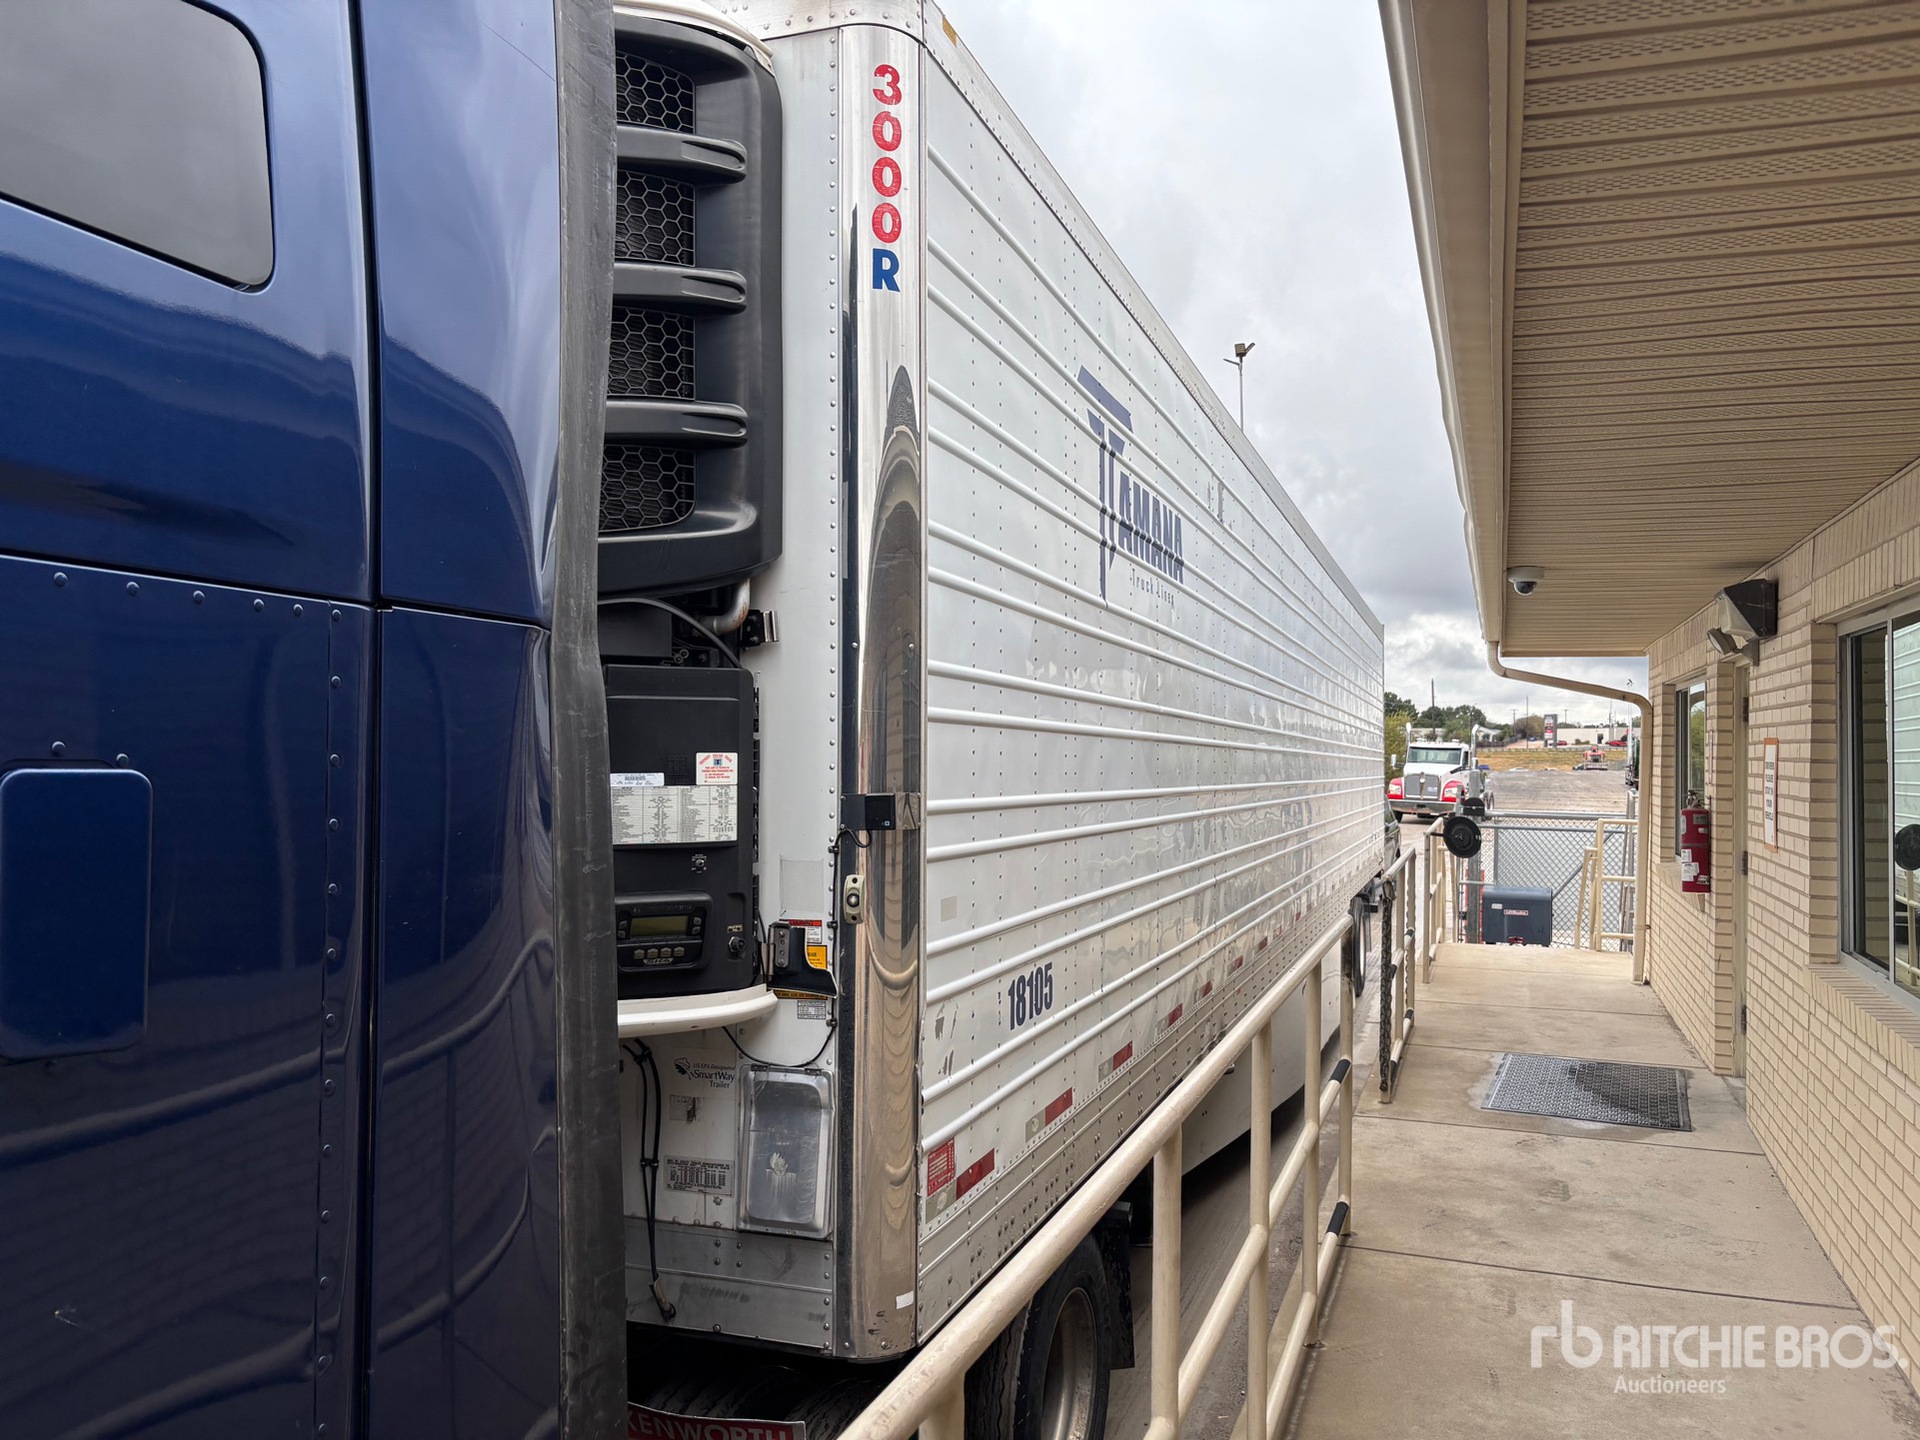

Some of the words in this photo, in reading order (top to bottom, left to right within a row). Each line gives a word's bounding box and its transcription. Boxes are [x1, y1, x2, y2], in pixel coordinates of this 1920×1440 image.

[872, 63, 902, 292] 3000R
[1008, 961, 1053, 1031] 18105
[692, 1069, 735, 1083] SmartWay
[709, 1080, 731, 1088] Trailer
